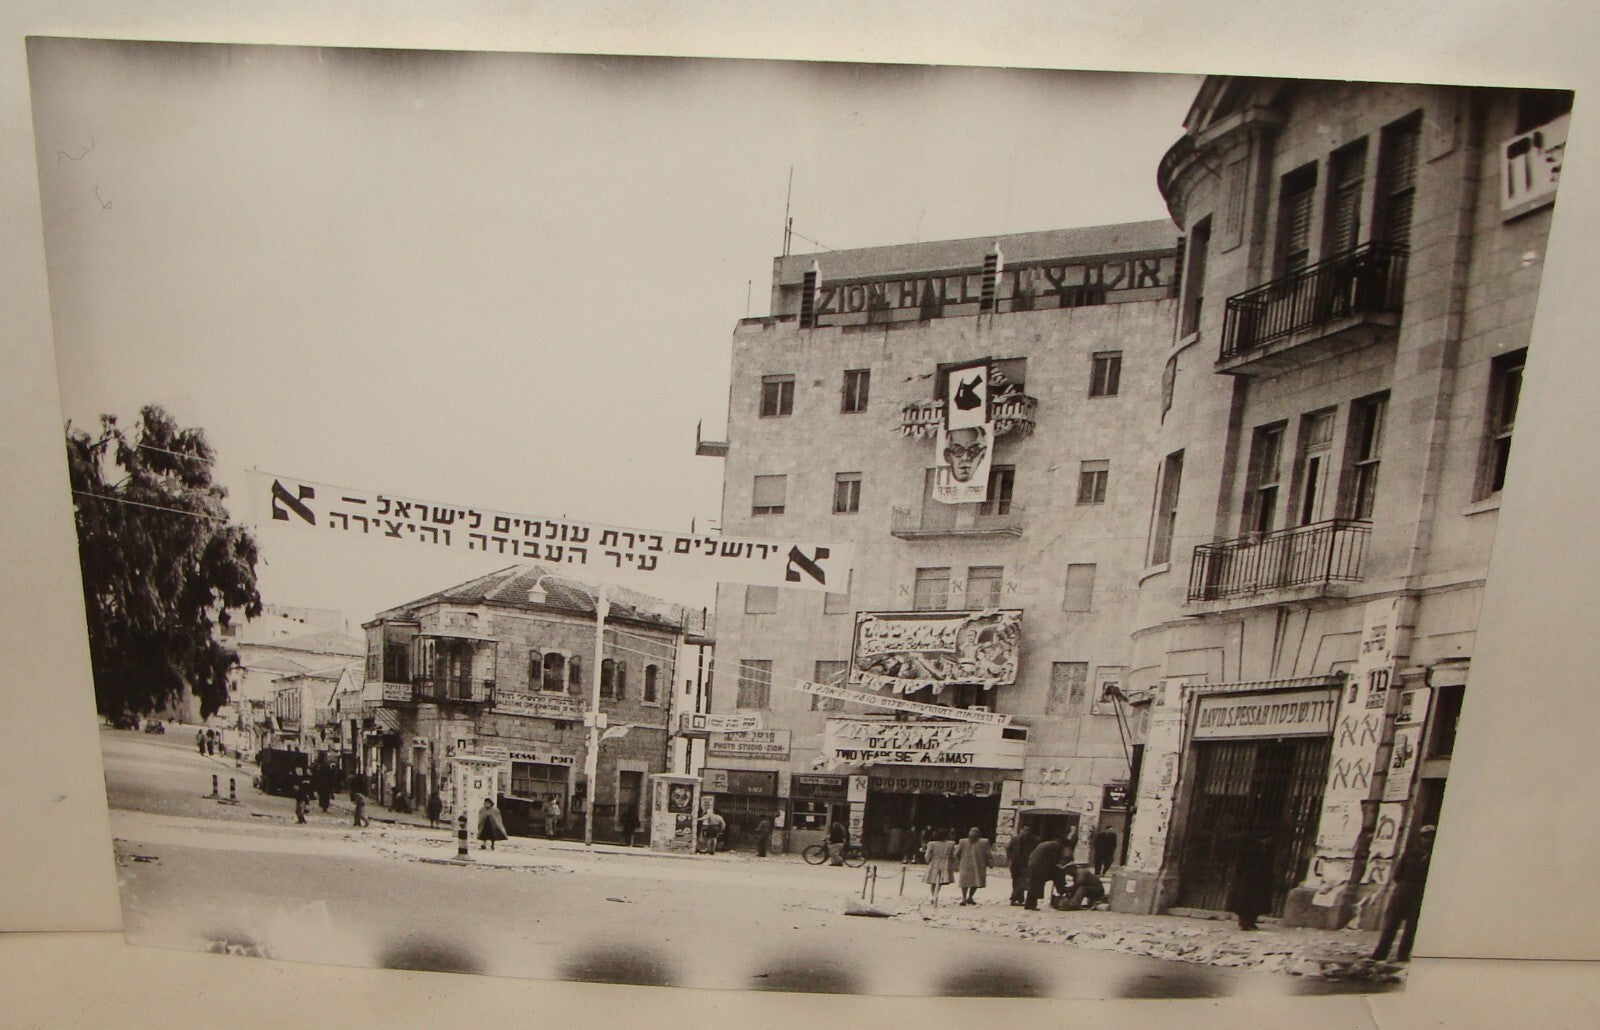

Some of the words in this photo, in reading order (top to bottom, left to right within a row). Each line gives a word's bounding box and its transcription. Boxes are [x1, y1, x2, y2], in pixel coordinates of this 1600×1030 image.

[814, 283, 889, 314] ZION
[899, 275, 981, 308] HALL
[272, 478, 316, 526] א
[376, 495, 483, 529] לישראל
[329, 511, 451, 546] והיצירה
[493, 515, 589, 543] עולמים
[599, 529, 664, 553] בירת
[468, 532, 588, 565] העבודה
[604, 550, 658, 571] עיר
[673, 536, 778, 560] ירושלים
[785, 544, 831, 586] א
